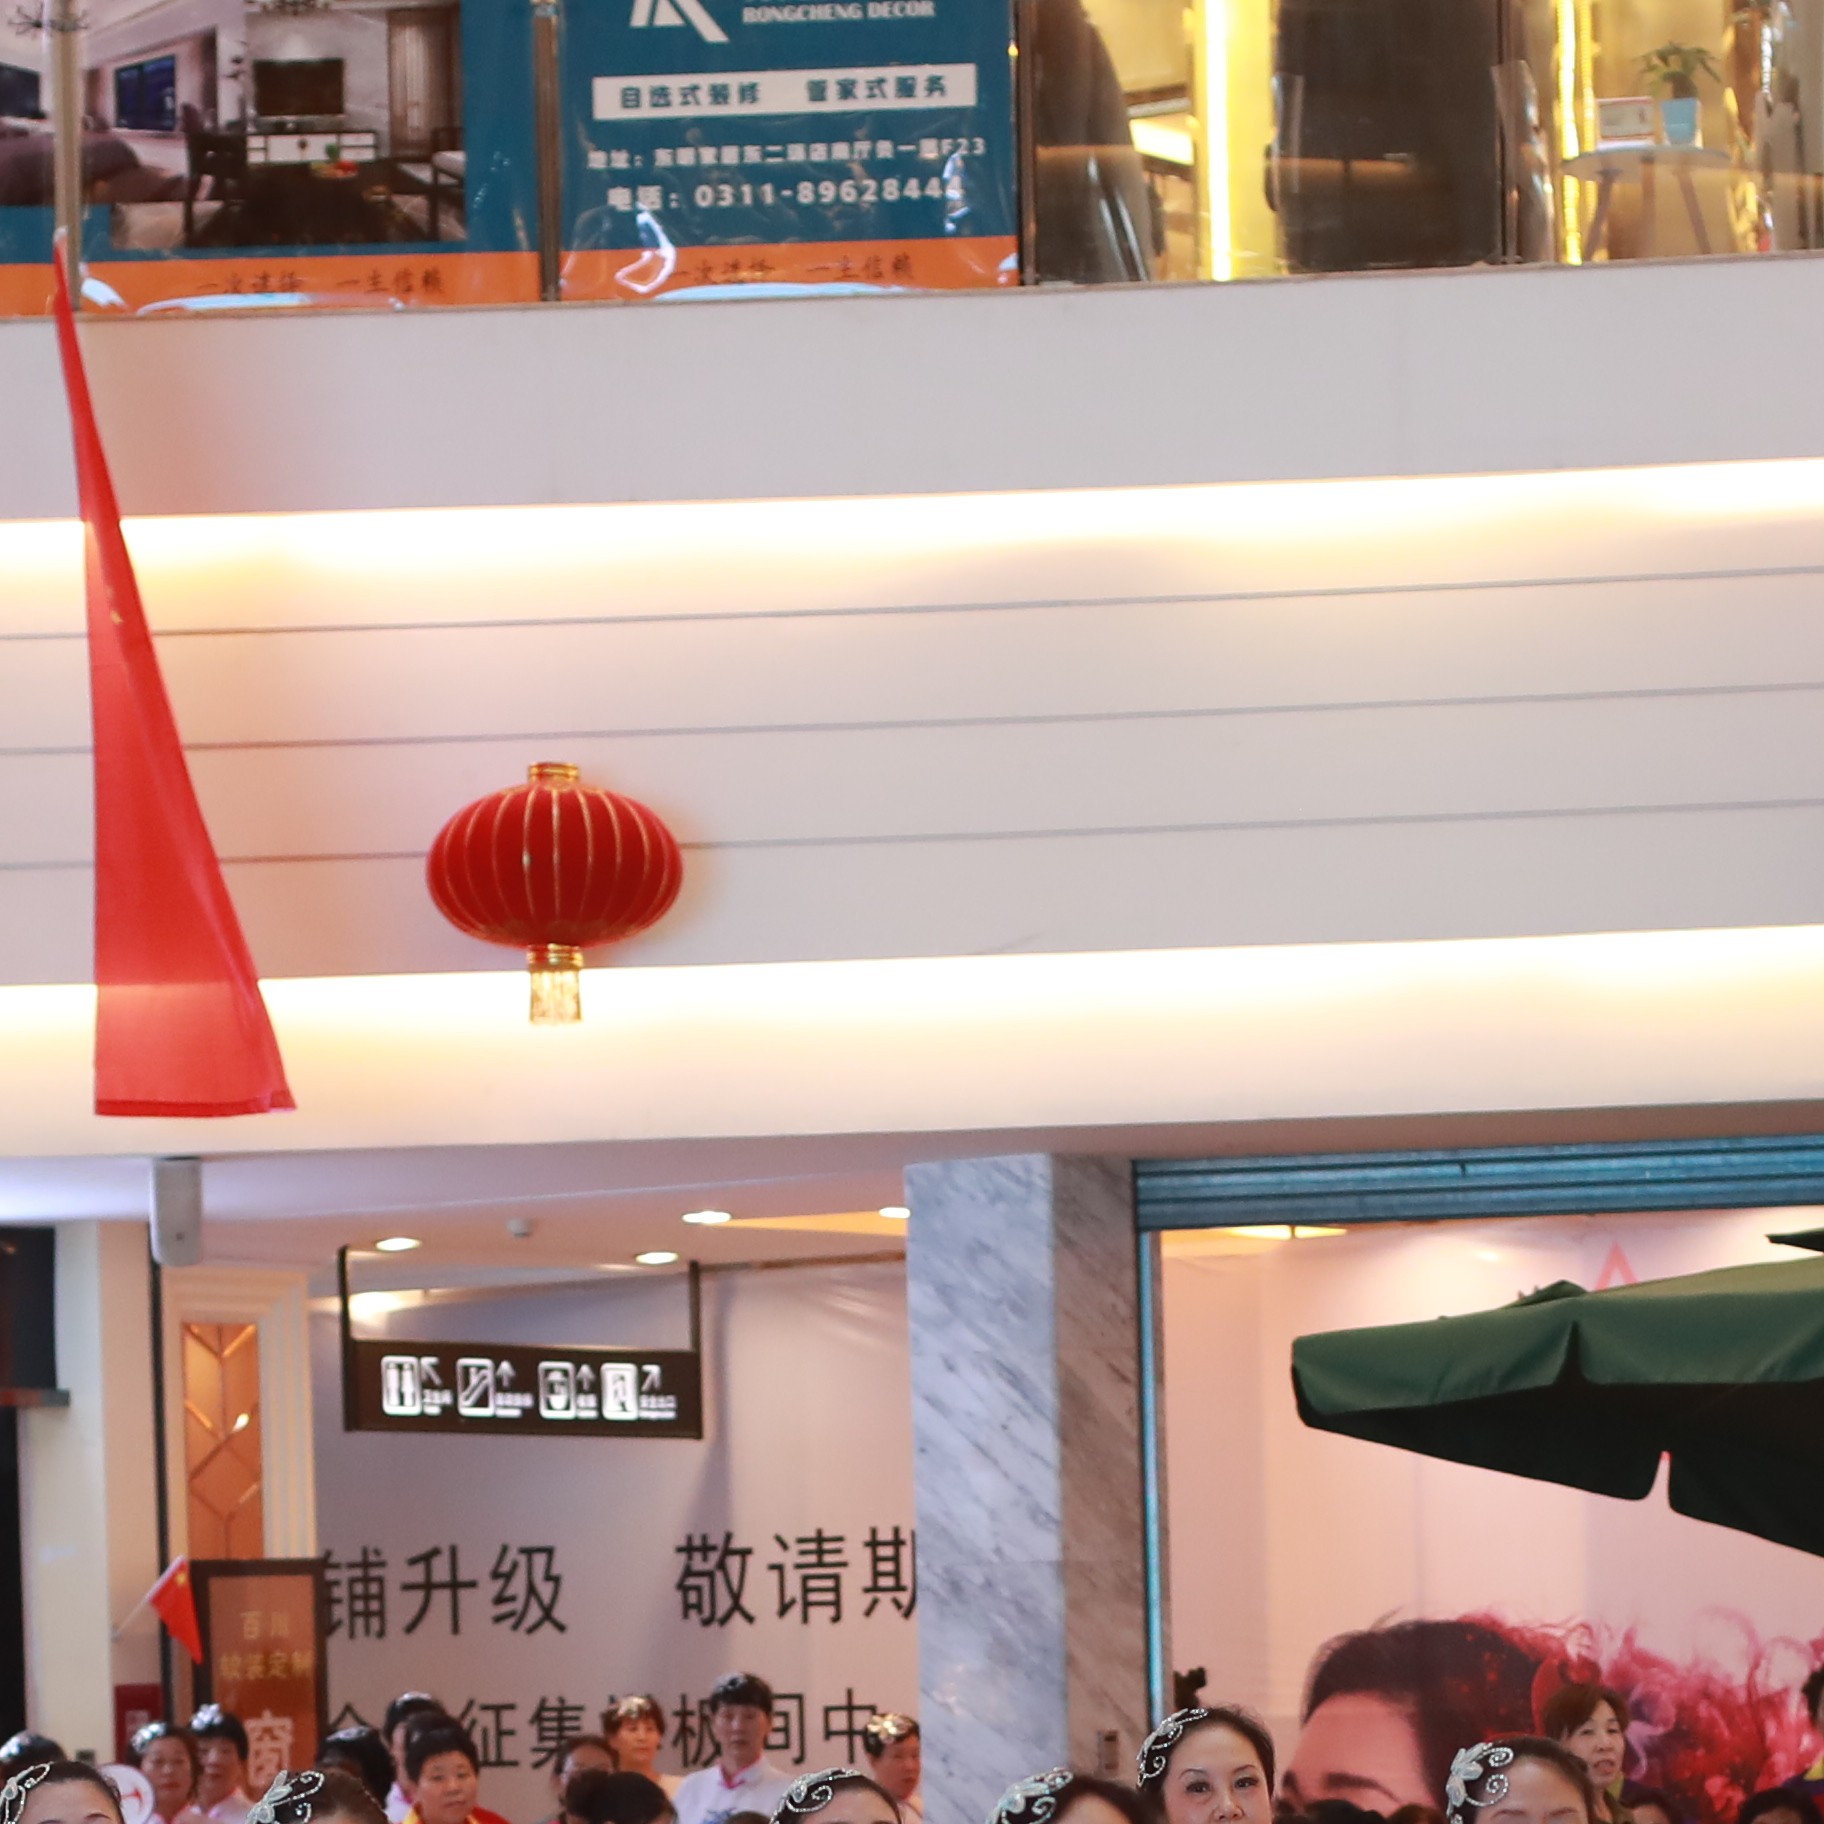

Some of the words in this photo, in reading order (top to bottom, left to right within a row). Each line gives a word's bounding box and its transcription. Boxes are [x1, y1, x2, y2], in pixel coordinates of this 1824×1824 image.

[742, 4, 863, 24] RONGCHENG
[866, 0, 936, 19] DECOR
[621, 82, 760, 110] 自选式装修
[806, 75, 948, 102] 管家式服务
